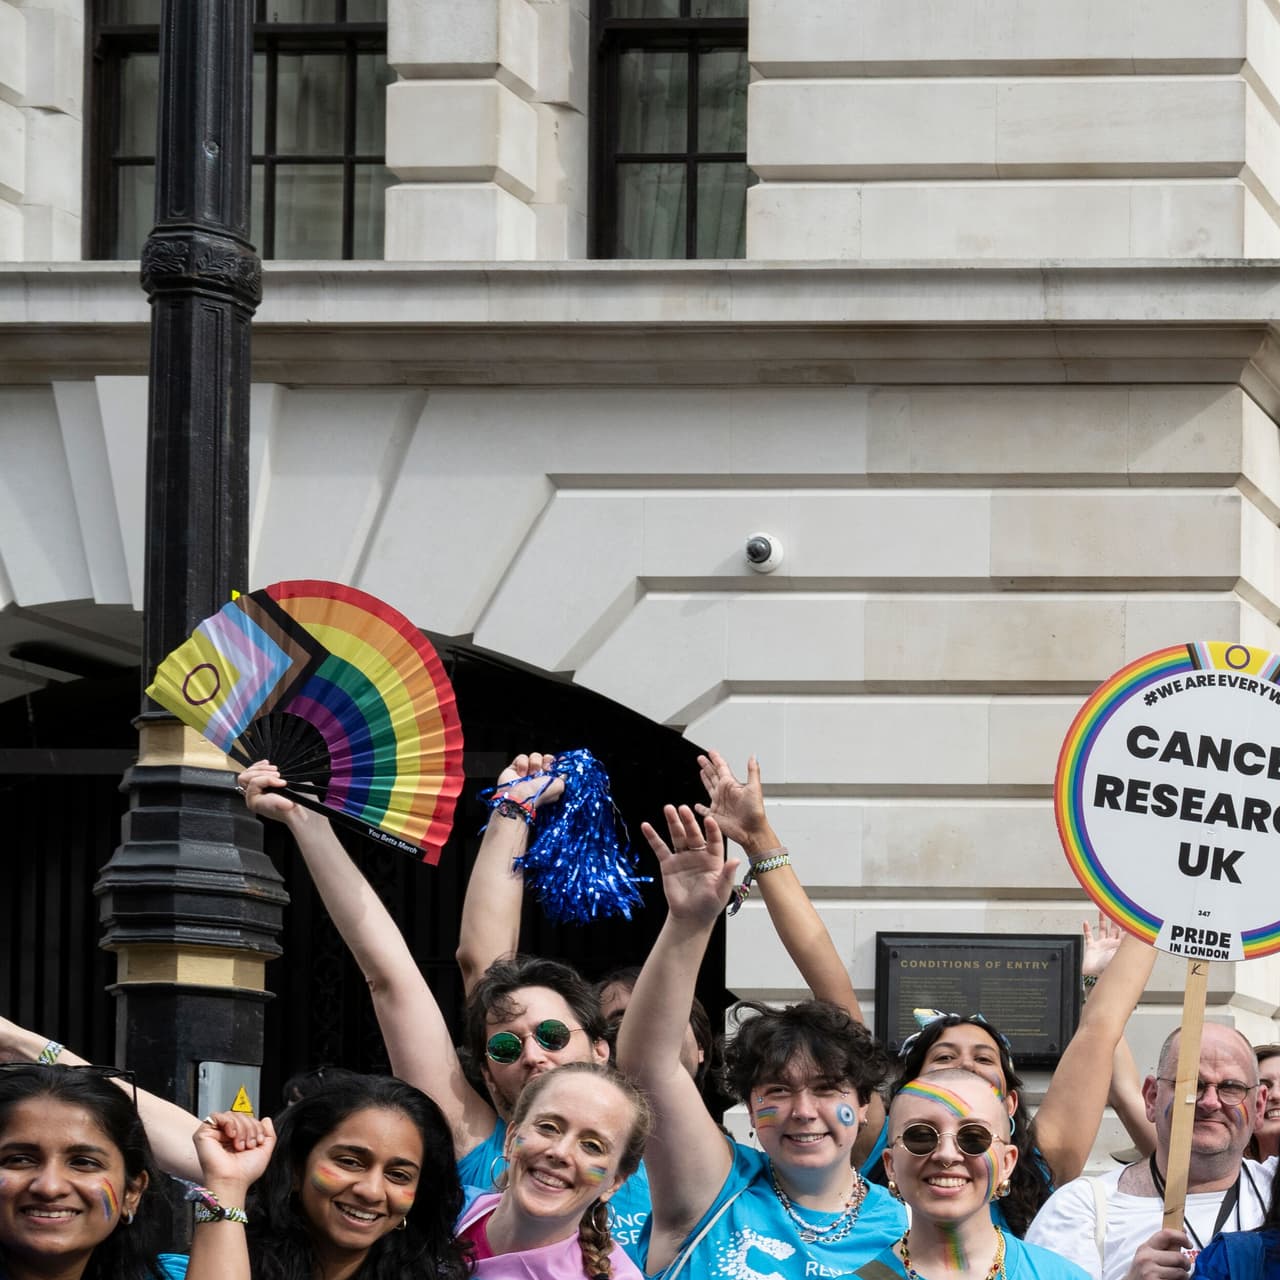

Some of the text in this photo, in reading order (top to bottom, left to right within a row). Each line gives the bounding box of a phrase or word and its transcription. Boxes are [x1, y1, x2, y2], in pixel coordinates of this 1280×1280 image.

[1143, 678, 1184, 707] #WE
[1184, 673, 1216, 689] ARE
[368, 828, 381, 839] You
[397, 841, 418, 855] Merch
[1177, 841, 1245, 885] UK
[1169, 942, 1230, 960] IN LONDON
[900, 959, 1050, 970] CONDITIONS OF ENTRY
[606, 1212, 648, 1229] ANC
